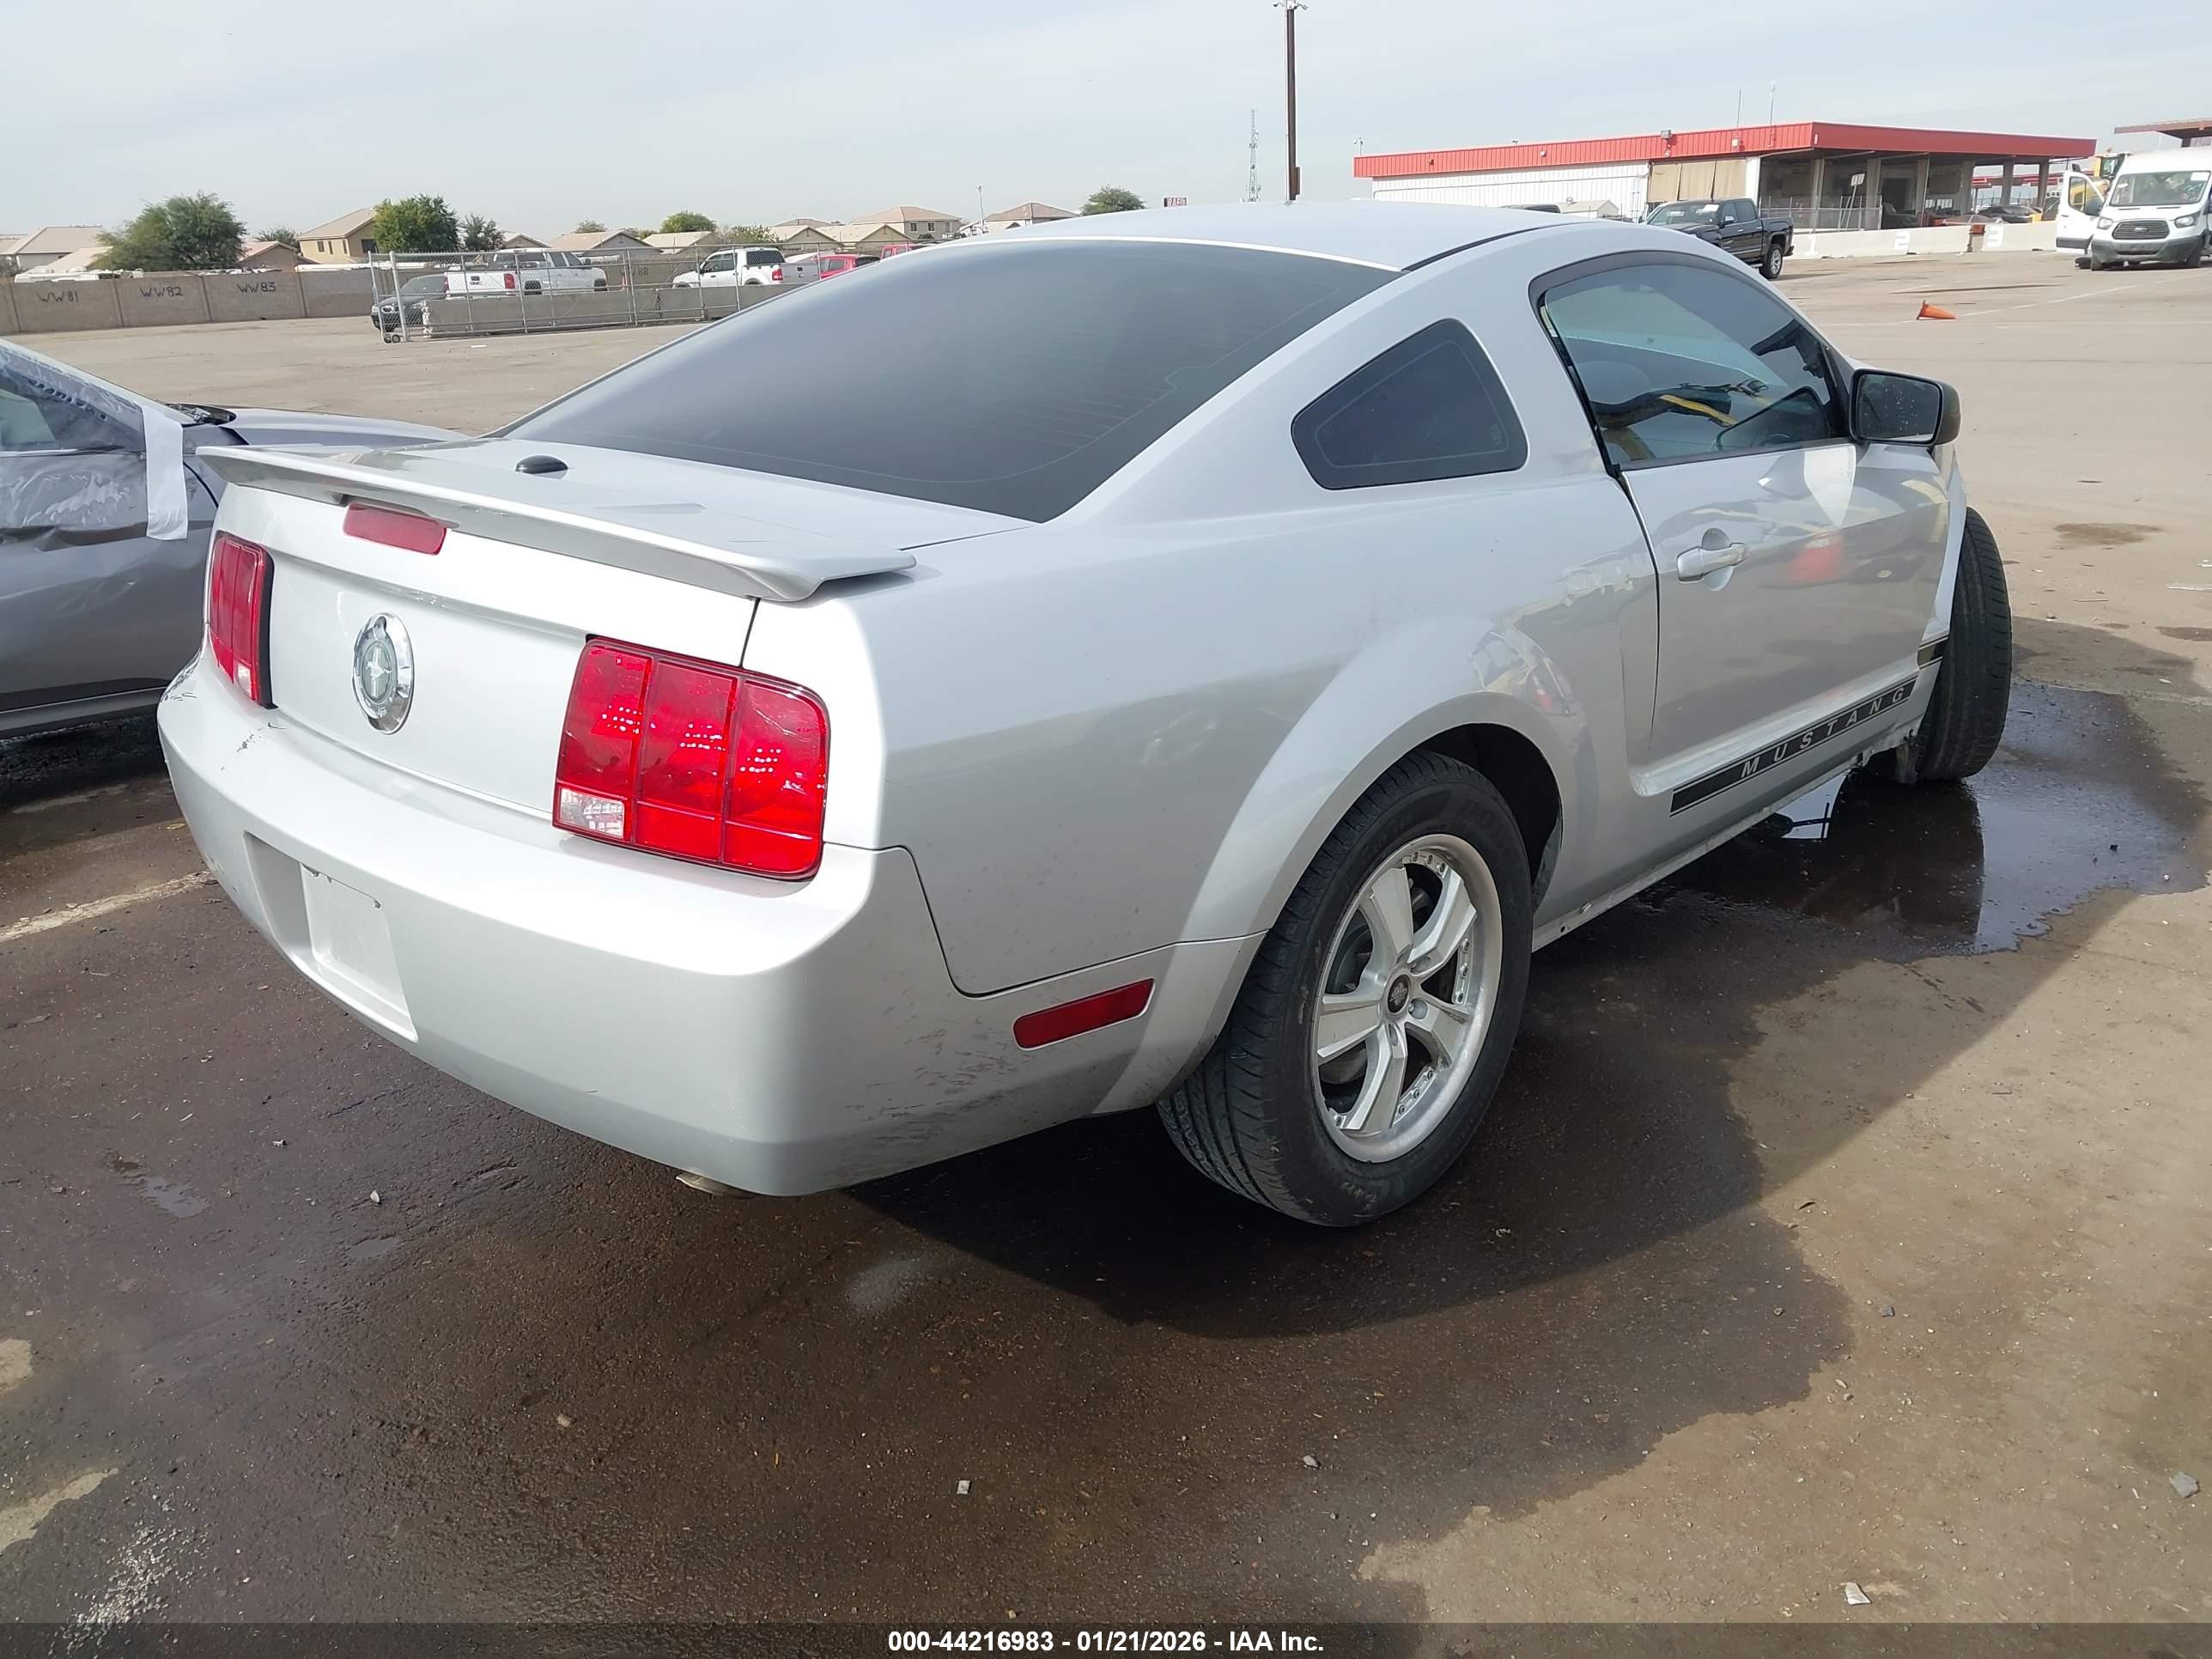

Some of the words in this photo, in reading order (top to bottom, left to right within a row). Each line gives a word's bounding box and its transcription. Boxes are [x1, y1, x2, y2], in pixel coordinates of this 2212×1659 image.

[1893, 230, 1911, 251] 2
[1986, 225, 2004, 247] 3
[139, 286, 185, 298] WW82
[1741, 686, 1905, 778] MUSTANG
